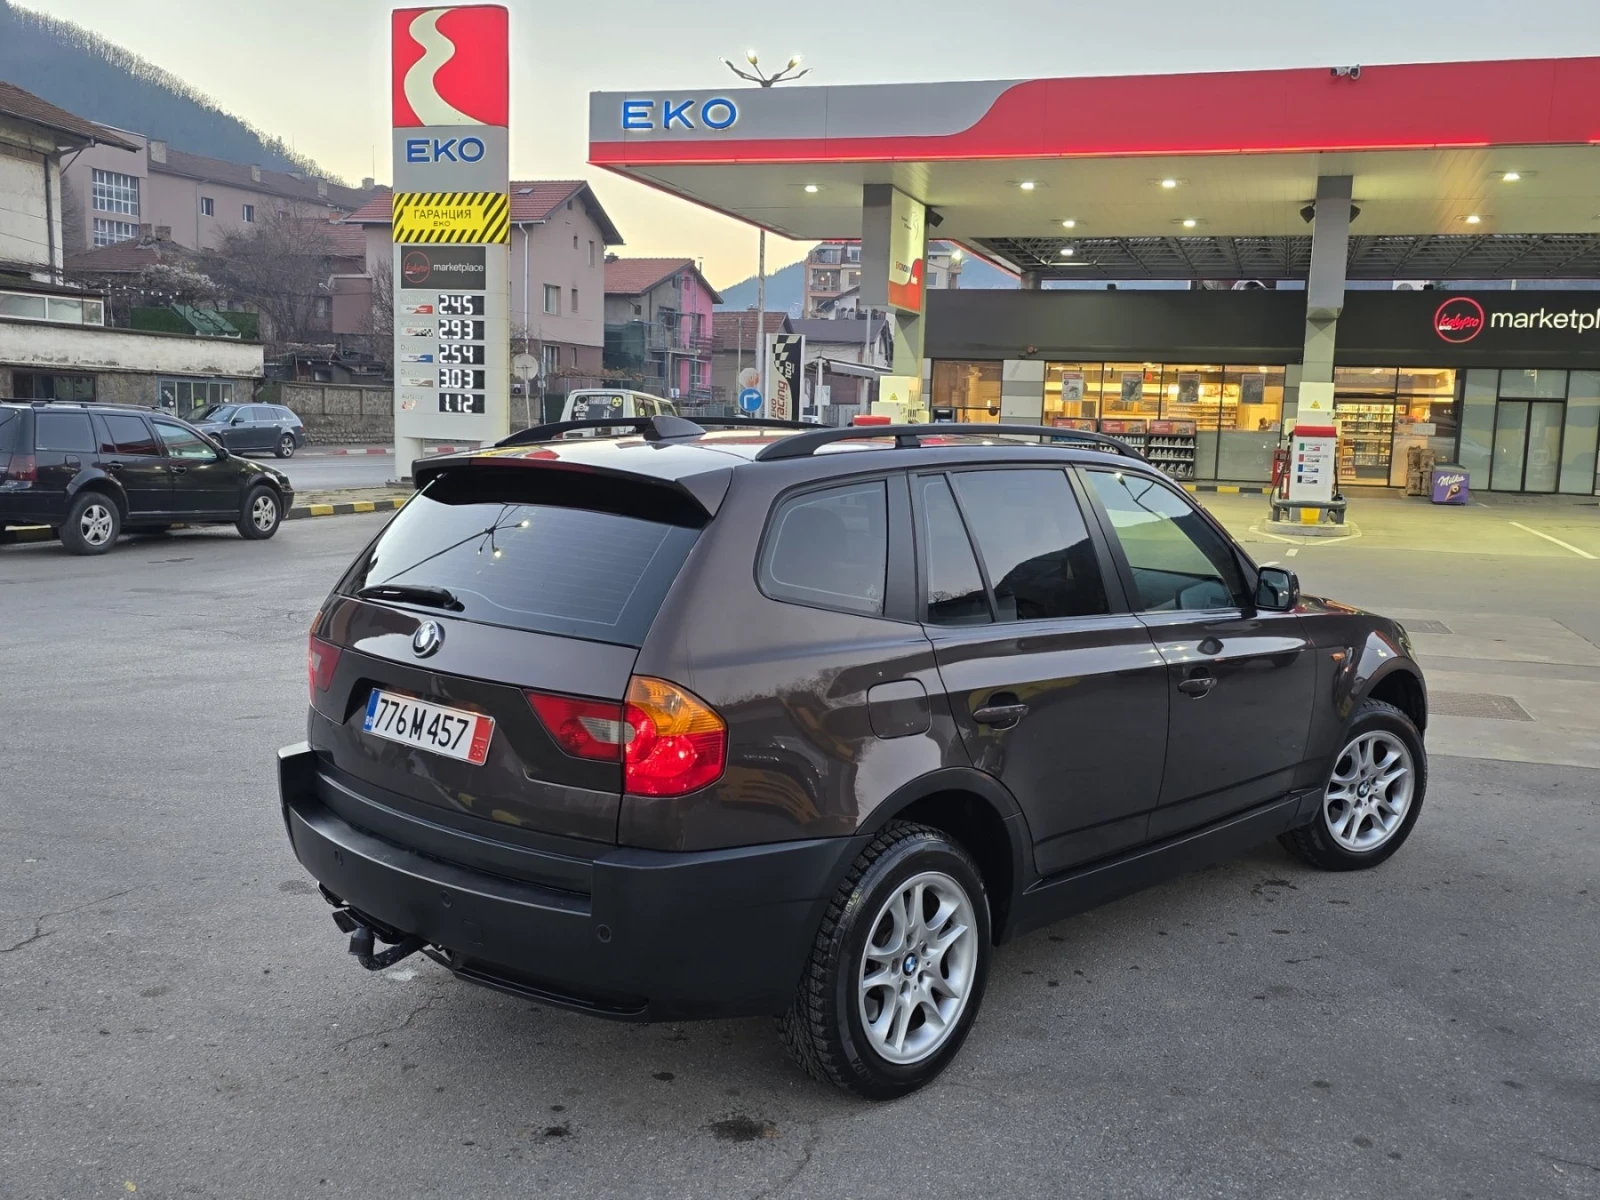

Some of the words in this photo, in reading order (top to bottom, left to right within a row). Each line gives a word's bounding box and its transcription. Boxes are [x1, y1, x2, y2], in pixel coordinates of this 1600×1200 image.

[622, 97, 737, 129] EKO
[406, 137, 485, 163] EKO
[413, 209, 472, 220] ГАРАНЦИЯ
[433, 262, 484, 273] marketplace
[439, 295, 474, 315] 2.45
[439, 319, 474, 340] 2.93
[439, 344, 474, 364] 2.54
[440, 368, 474, 389] 3.03
[445, 394, 474, 413] 1.12
[1437, 474, 1466, 487] Milka
